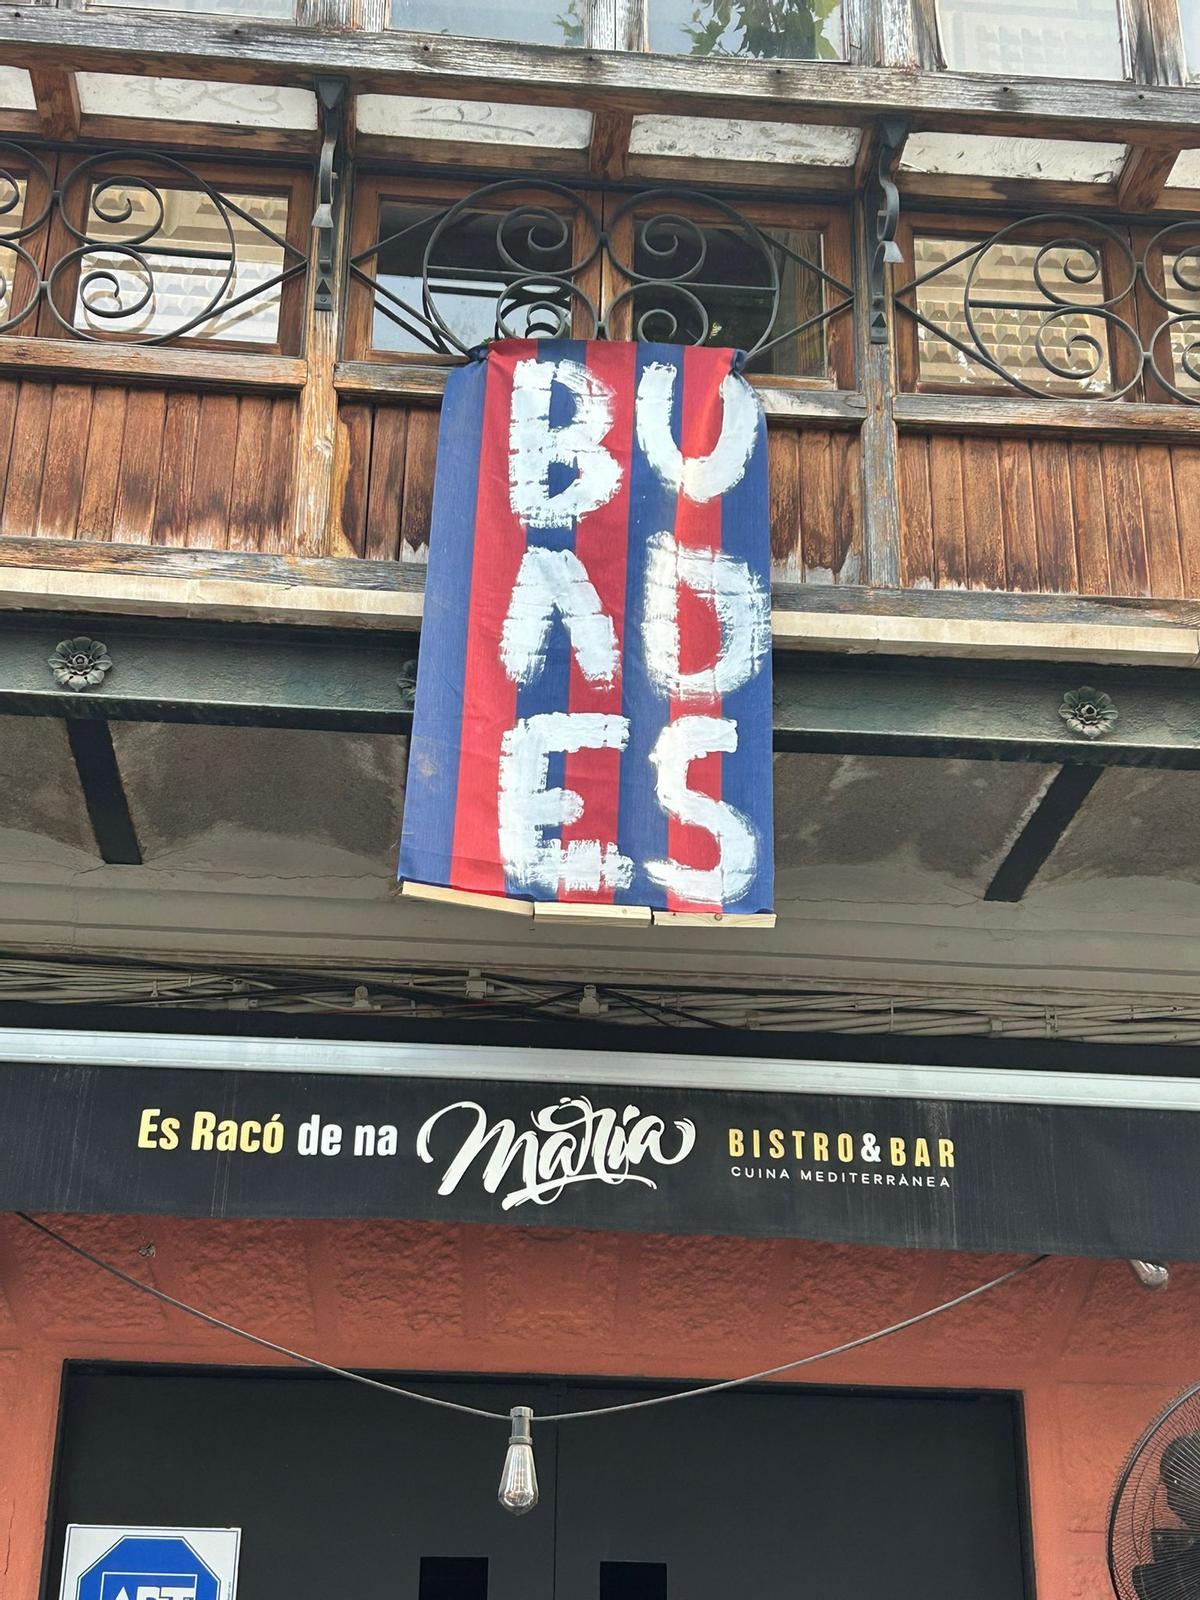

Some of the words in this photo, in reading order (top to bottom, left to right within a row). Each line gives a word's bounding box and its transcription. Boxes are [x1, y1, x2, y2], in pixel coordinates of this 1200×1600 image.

[137, 1108, 181, 1150] Es
[190, 1110, 285, 1154] Racó
[298, 1114, 343, 1157] de
[353, 1124, 398, 1157] na
[731, 1166, 790, 1180] CUINA
